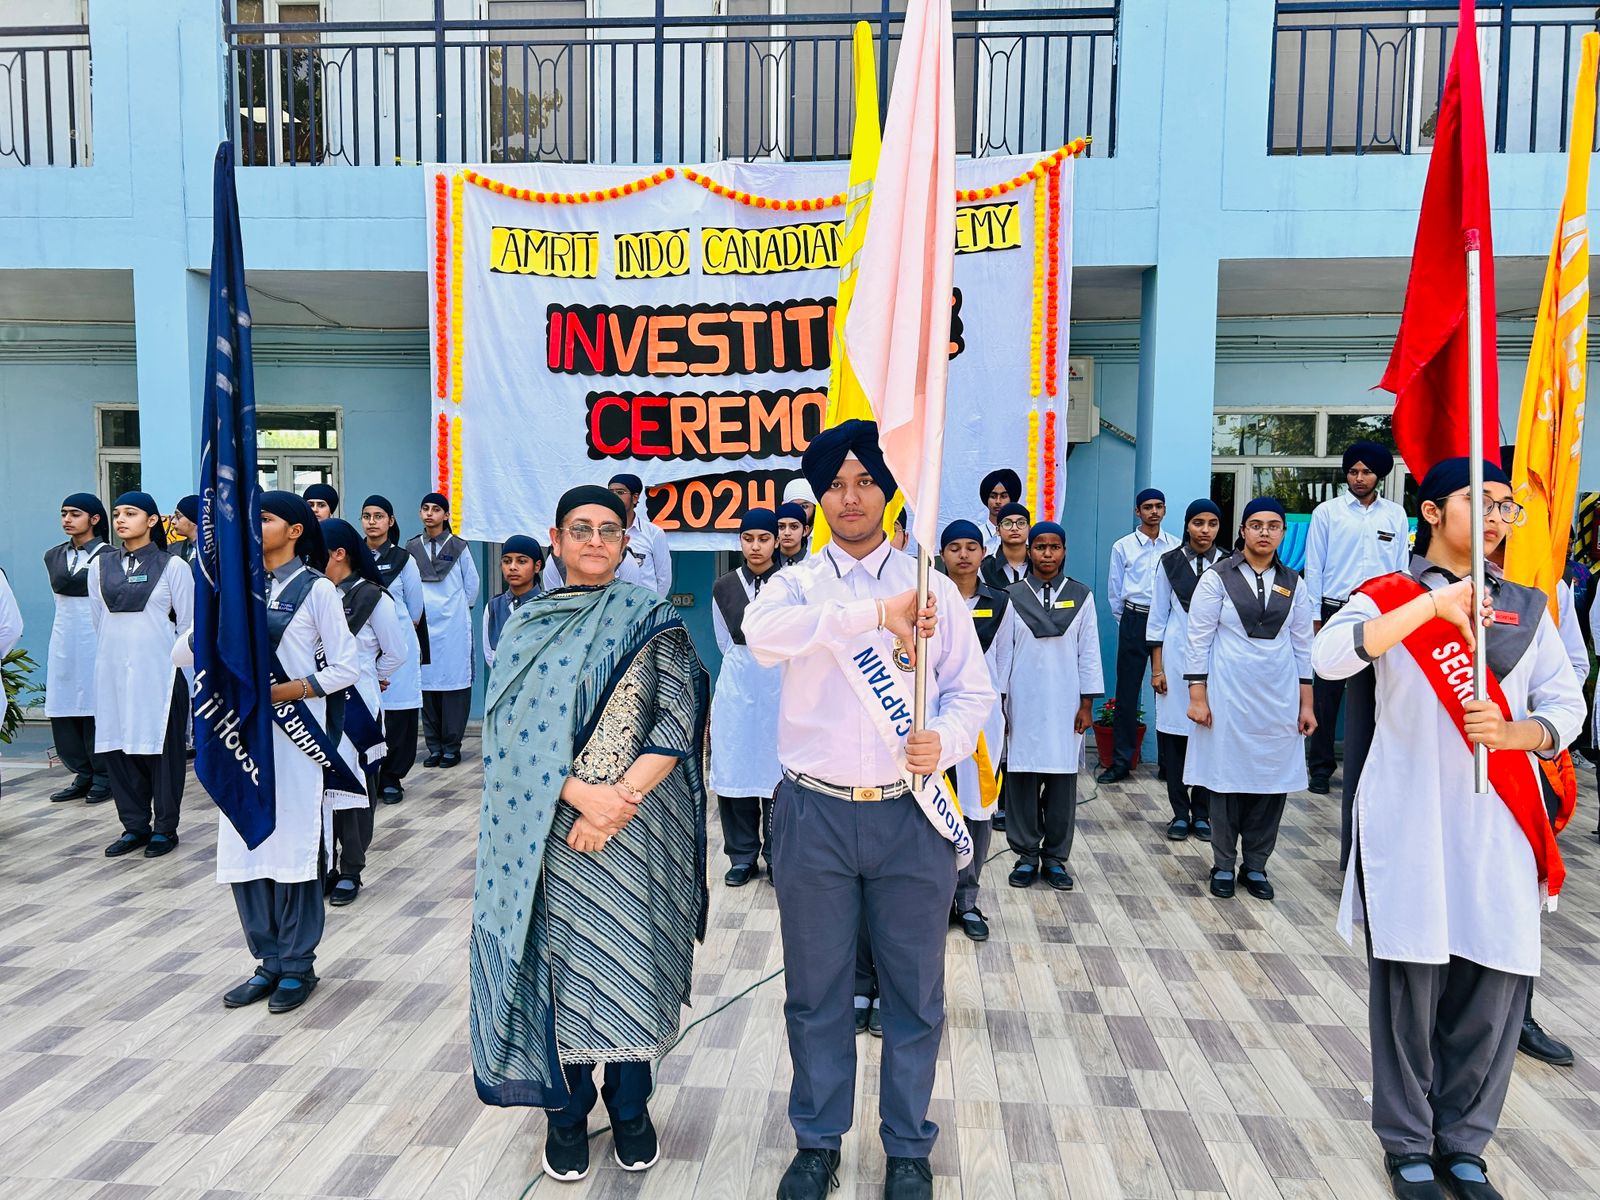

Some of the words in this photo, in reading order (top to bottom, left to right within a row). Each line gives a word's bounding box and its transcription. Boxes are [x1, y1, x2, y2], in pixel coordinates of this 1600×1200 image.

[500, 232, 597, 272] AMRIT
[618, 235, 685, 273] INDO
[590, 392, 829, 456] CEREMO
[649, 479, 776, 530] 2024
[852, 646, 913, 738] CAPTAIN
